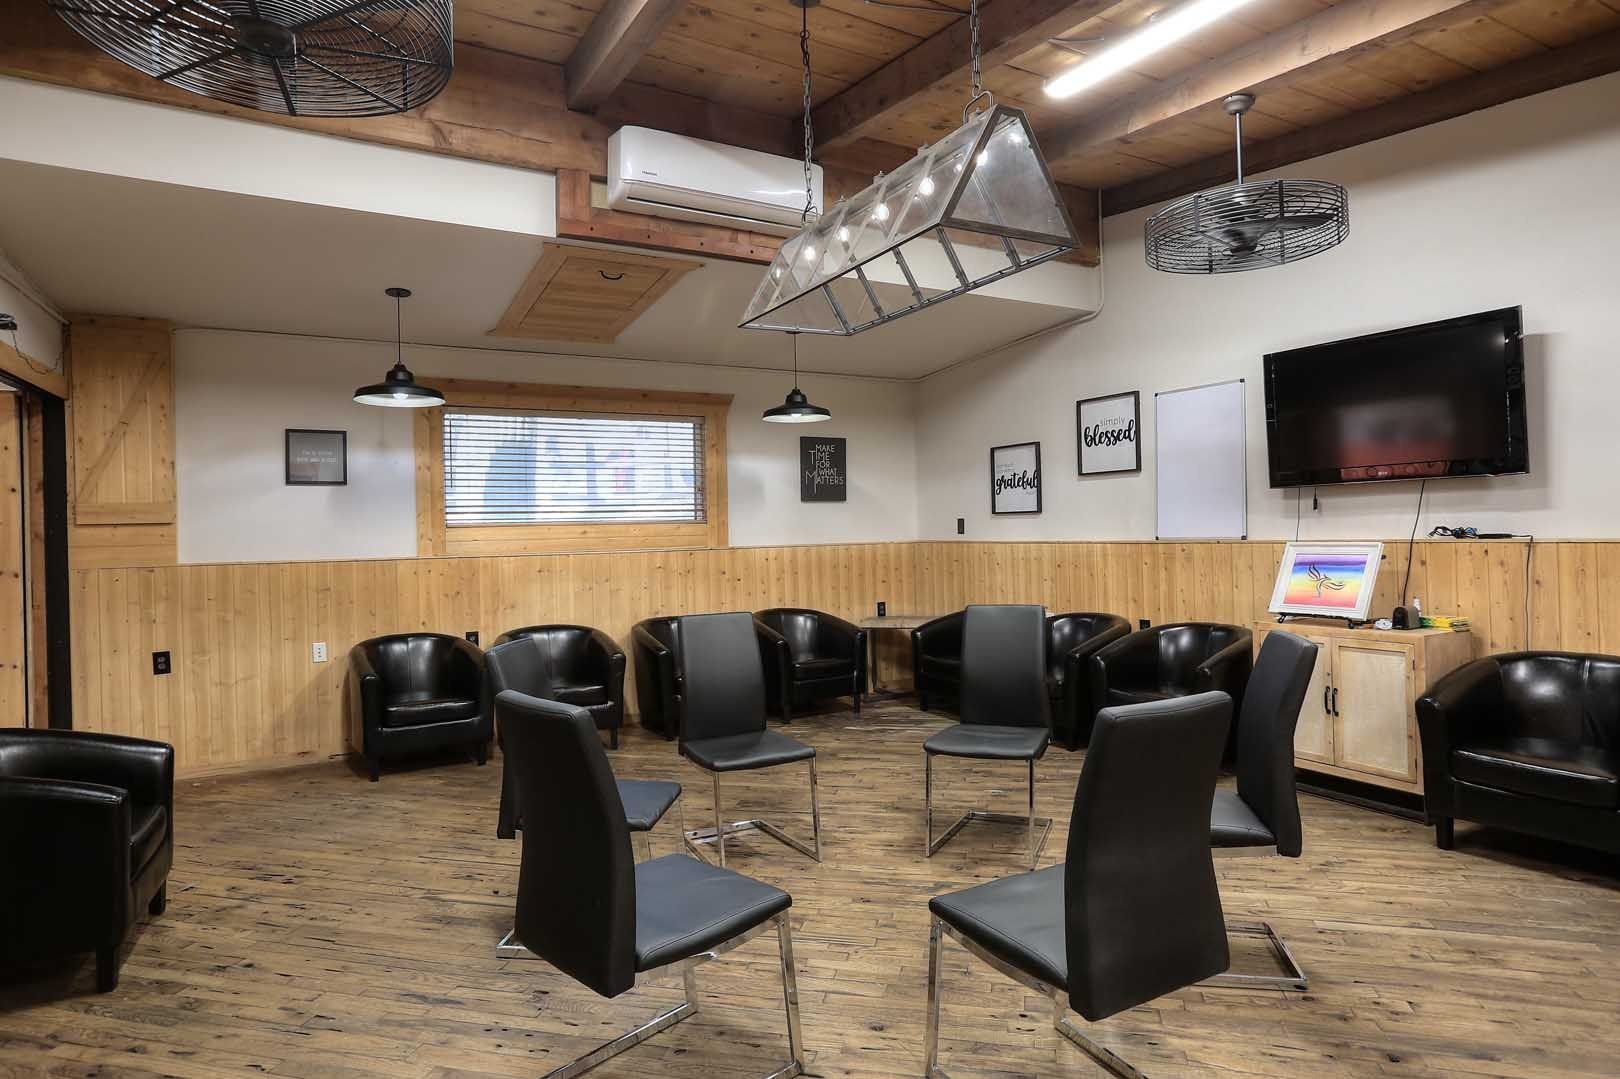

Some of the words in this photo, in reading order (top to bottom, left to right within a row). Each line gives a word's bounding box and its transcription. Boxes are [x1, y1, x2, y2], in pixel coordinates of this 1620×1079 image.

[1100, 416, 1126, 428] simply
[1084, 419, 1136, 447] blessed
[815, 444, 836, 452] MAKE
[807, 450, 830, 464] TIME
[815, 460, 830, 468] FOR
[818, 468, 838, 477] WHAT
[805, 470, 844, 494] MATTERS
[995, 470, 1039, 495] grateful
